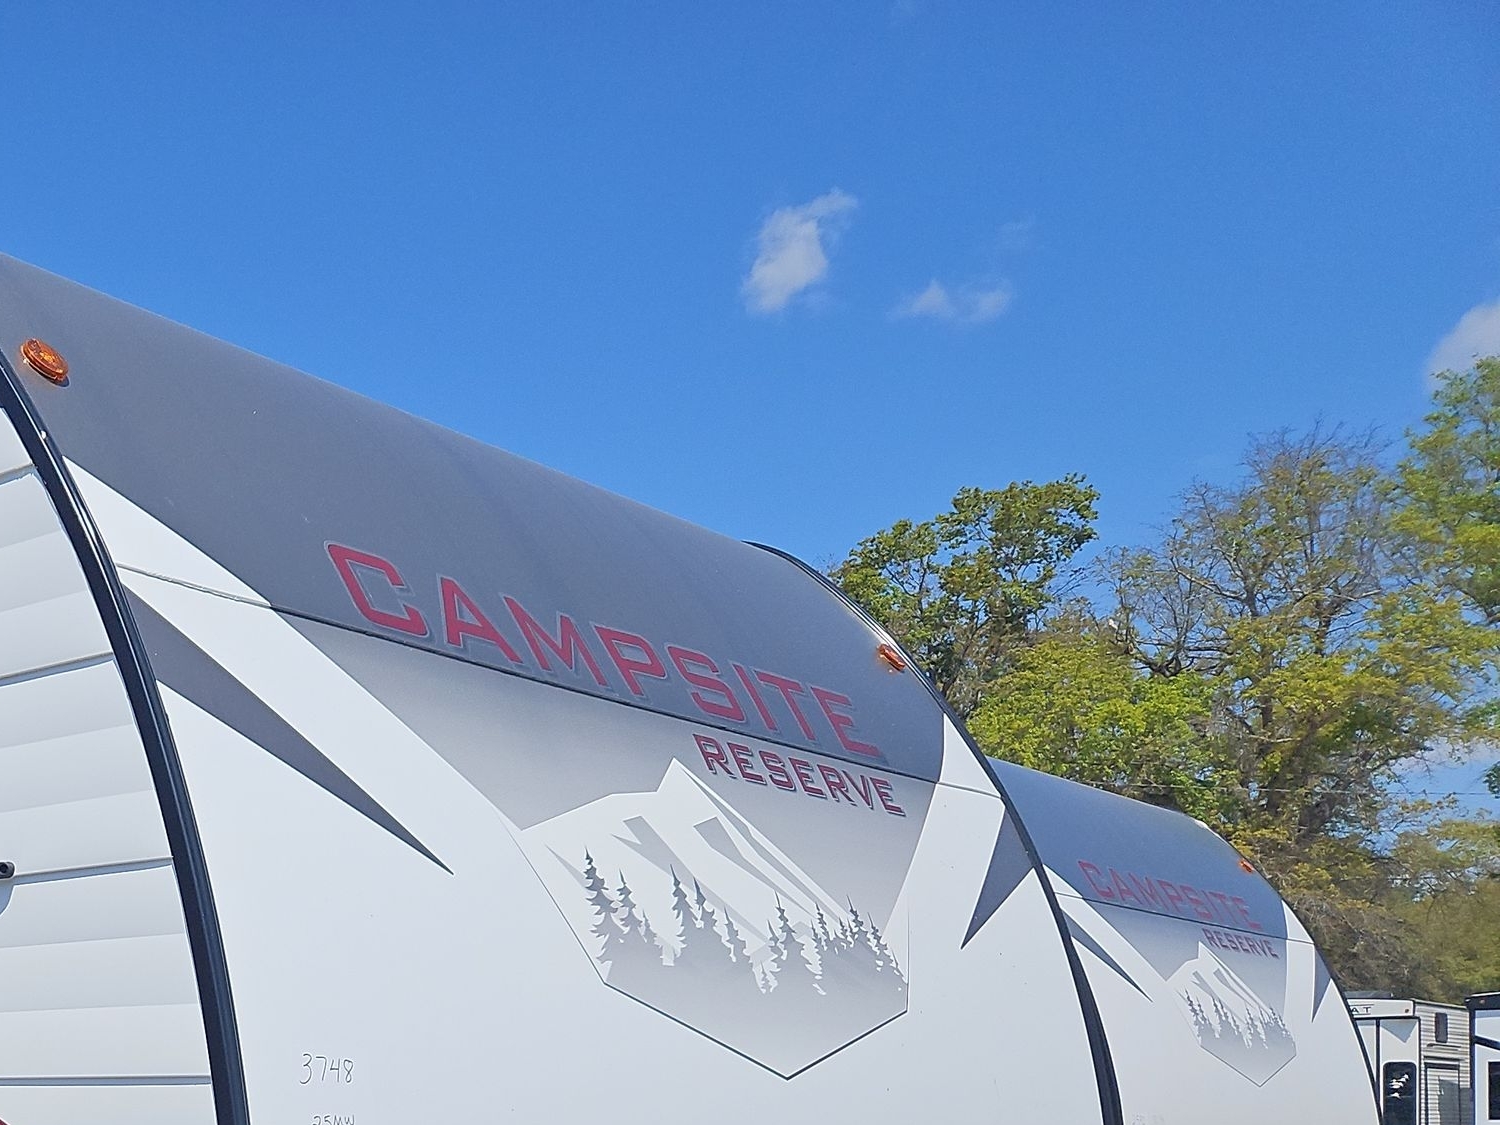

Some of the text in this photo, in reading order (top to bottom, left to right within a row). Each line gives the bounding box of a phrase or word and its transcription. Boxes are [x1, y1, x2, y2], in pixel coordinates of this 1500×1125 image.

[326, 542, 884, 757] CAMPSITE
[693, 734, 905, 816] RESERVE
[1078, 860, 1262, 930] CAMPSITE
[1202, 928, 1279, 959] RESERVE
[299, 1053, 354, 1085] 3748
